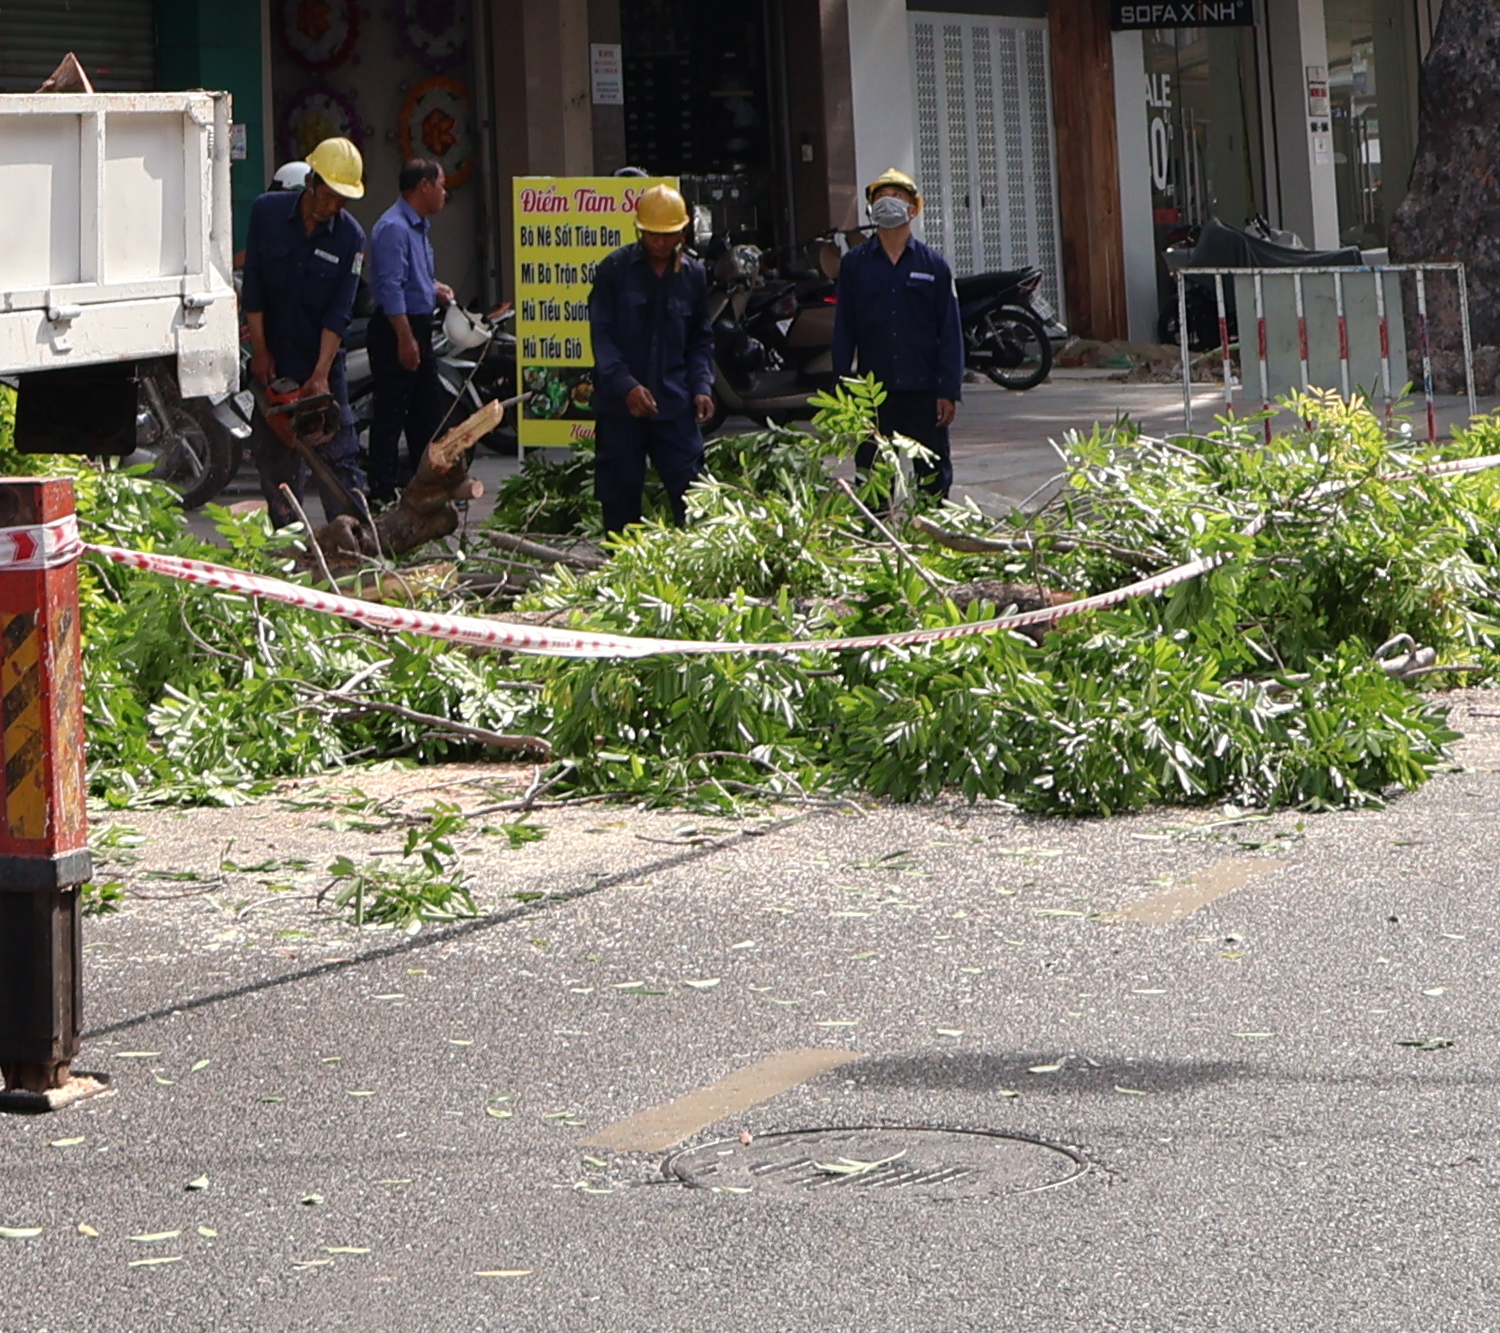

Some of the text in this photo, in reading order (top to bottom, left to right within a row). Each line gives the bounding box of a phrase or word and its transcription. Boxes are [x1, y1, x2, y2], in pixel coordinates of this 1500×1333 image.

[520, 185, 570, 213] Điểm
[574, 188, 617, 213] Tâm
[555, 223, 572, 247] Sốt
[575, 225, 597, 247] Tiêu
[601, 225, 621, 247] Đen
[555, 263, 578, 289] Trộn
[522, 298, 535, 321] Hủ
[539, 296, 560, 322] Tiếu
[523, 334, 582, 359] Hủ Tiếu Giò
